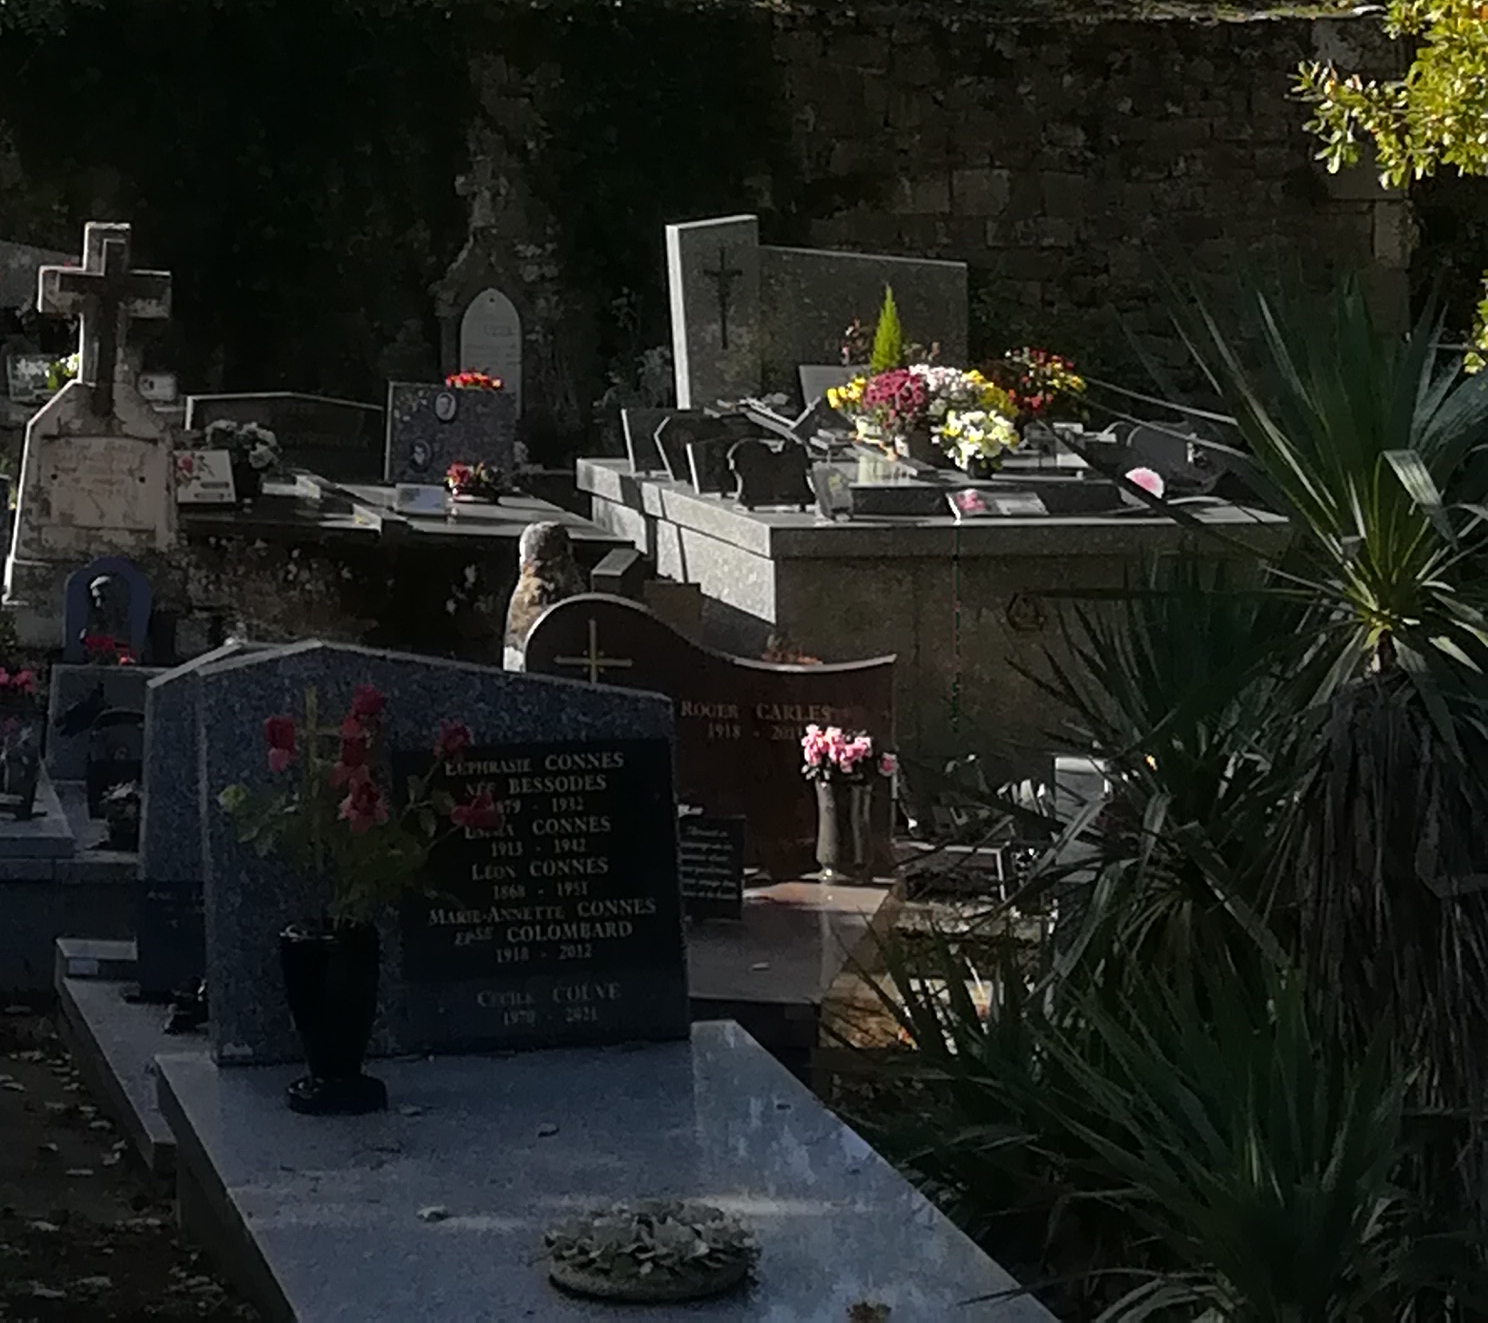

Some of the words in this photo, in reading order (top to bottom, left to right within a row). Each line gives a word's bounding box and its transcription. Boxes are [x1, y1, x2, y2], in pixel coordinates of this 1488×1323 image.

[755, 704, 832, 721] CARLES
[544, 752, 625, 772] CONNES
[508, 774, 608, 795] BESSODES
[532, 816, 612, 836] CONNES
[529, 858, 610, 878] CONNES
[576, 898, 657, 918] CONNES
[506, 921, 635, 944] COLOMBARD
